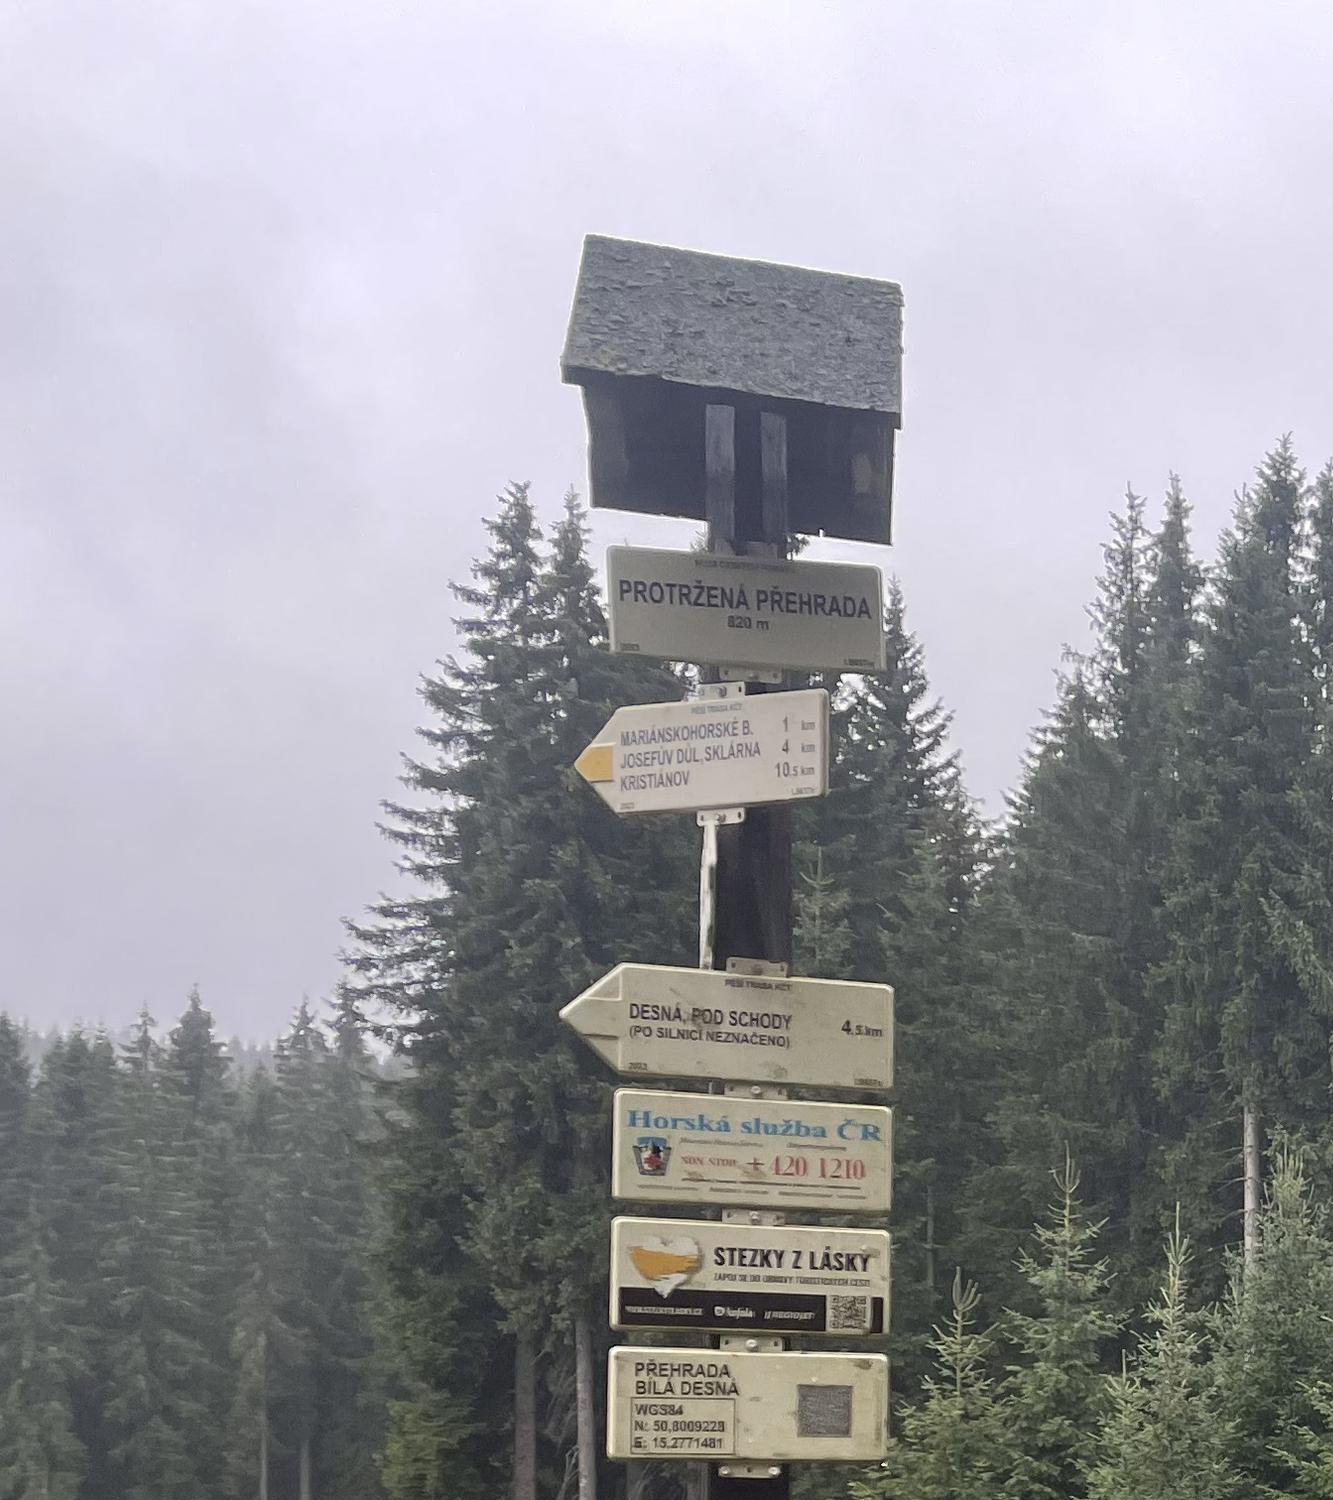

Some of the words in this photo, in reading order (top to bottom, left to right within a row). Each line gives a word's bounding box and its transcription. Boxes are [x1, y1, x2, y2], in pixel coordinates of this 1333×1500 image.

[619, 578, 750, 611] PROTRŽENÁ
[756, 585, 872, 619] PŘEHRADA
[756, 619, 769, 631] m
[620, 717, 739, 746] MARIÁNSKOHORSKÉ
[742, 719, 754, 736] B.
[782, 716, 788, 732] 1
[801, 720, 815, 731] km
[621, 746, 673, 768] JOSEFŮV
[704, 741, 761, 762] SKLÁRNA
[782, 739, 789, 754] 4
[801, 743, 815, 753] km
[620, 768, 690, 792] KRISTIÁNOV
[800, 766, 815, 776] km
[691, 1007, 723, 1026] POD
[729, 1011, 792, 1031] SCHODY
[864, 1024, 883, 1038] km
[629, 1025, 653, 1040] (PO
[706, 1029, 791, 1049] NEZNAČENO)
[627, 1109, 732, 1134] Horská
[740, 1116, 827, 1138] služba
[837, 1118, 883, 1142] ČR
[771, 1155, 807, 1177] 420
[818, 1157, 866, 1179] 1210
[714, 1246, 786, 1269] STEZKY
[792, 1250, 806, 1270] Z
[809, 1246, 871, 1273] LÁSKY
[634, 1359, 731, 1378] PŘEHRADA
[635, 1377, 675, 1395] BÍLÁ
[681, 1377, 740, 1396] DESNÁ
[635, 1403, 684, 1416] WGS84
